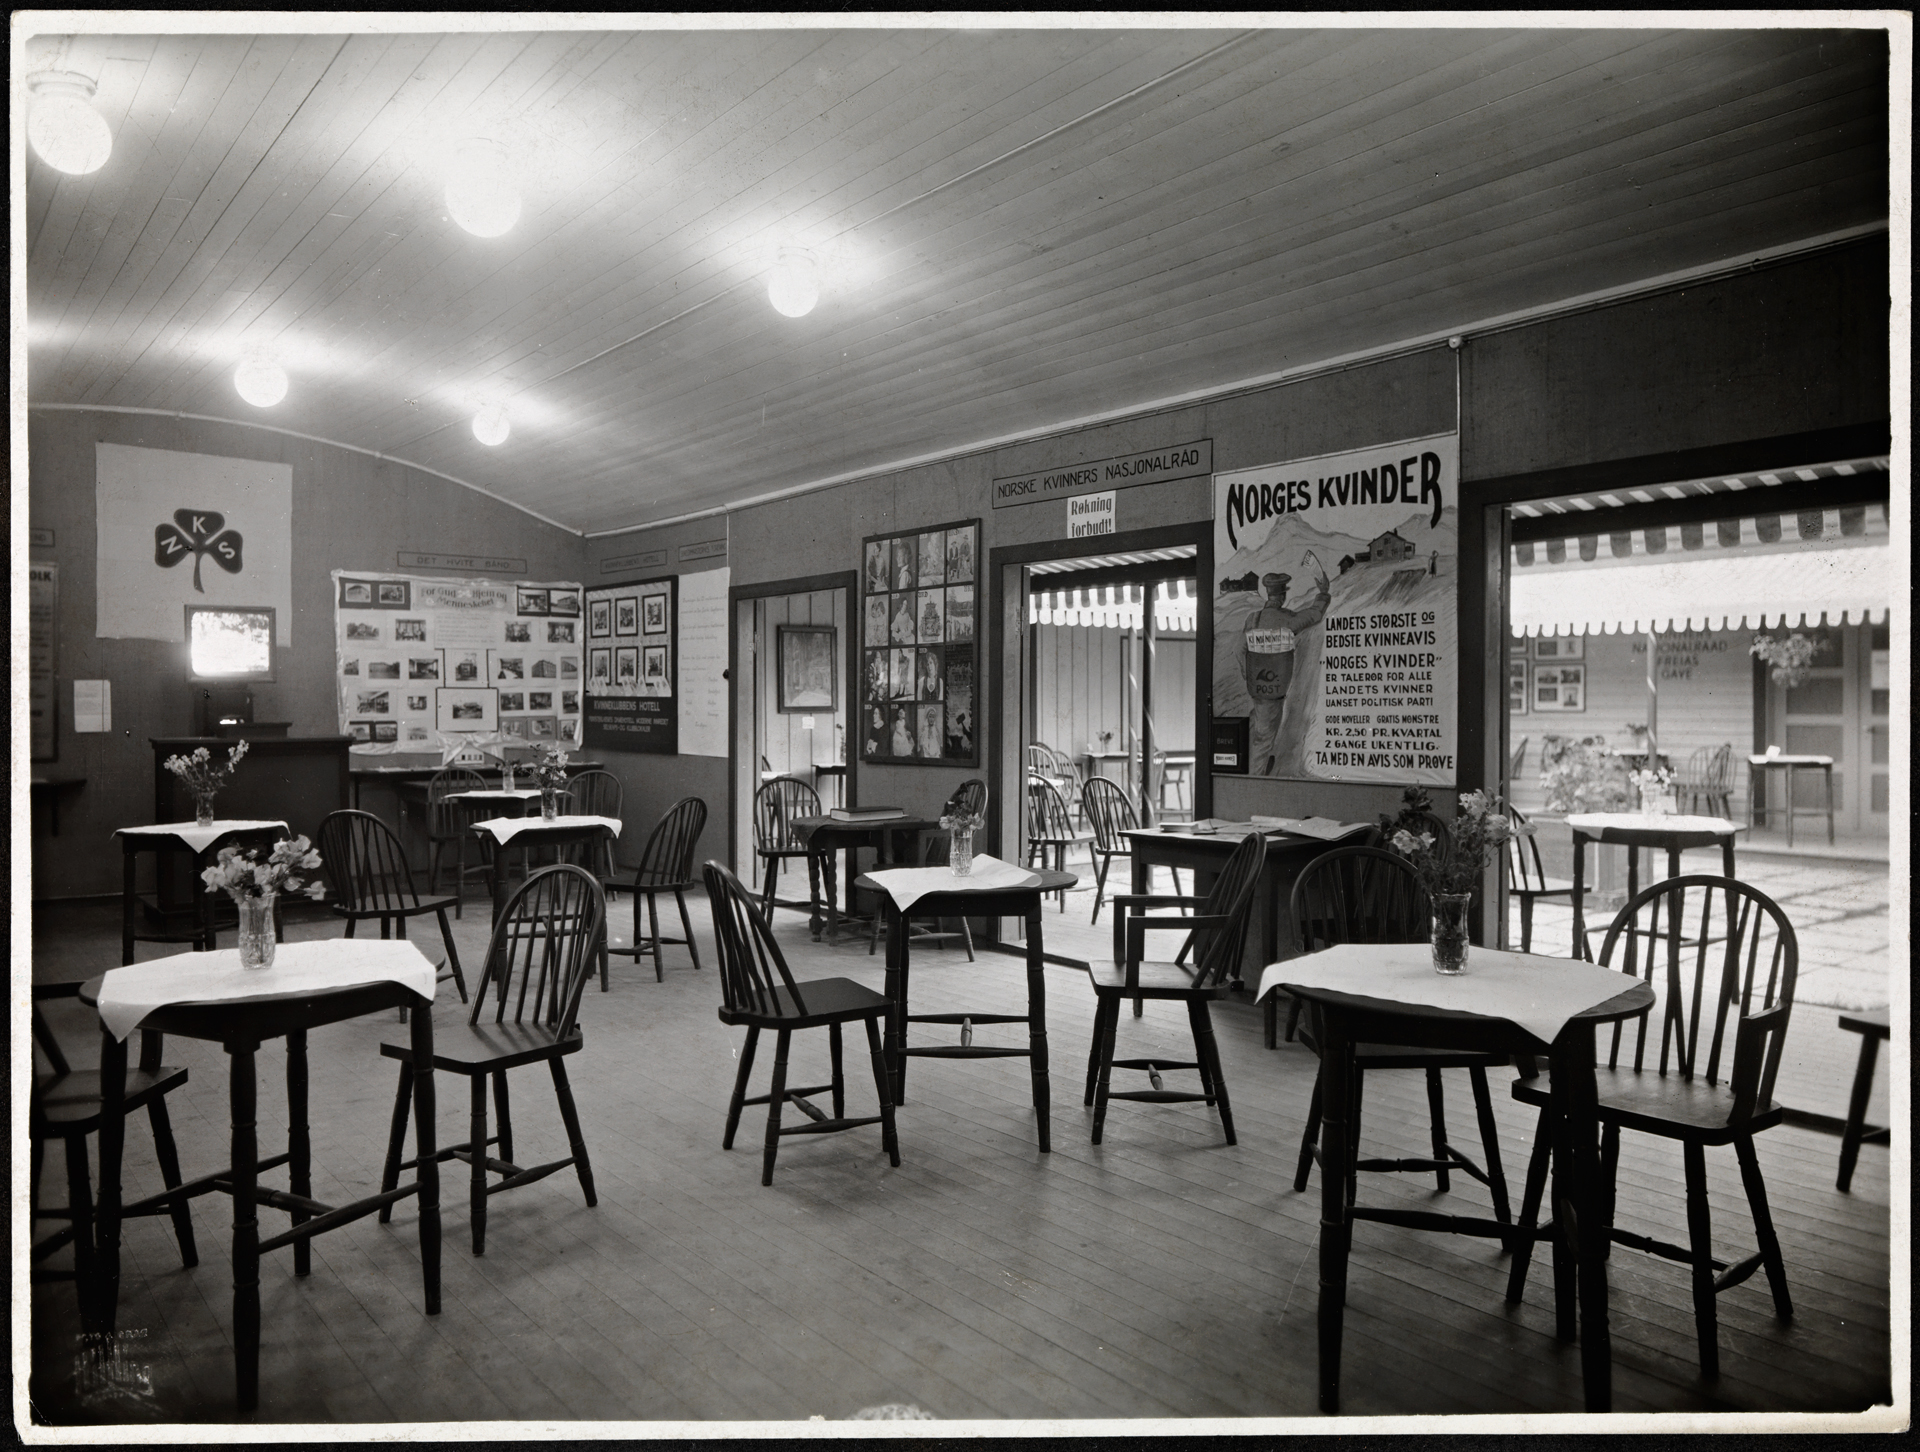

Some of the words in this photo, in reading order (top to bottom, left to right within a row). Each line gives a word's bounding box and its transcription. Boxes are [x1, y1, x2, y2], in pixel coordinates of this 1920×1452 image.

[998, 479, 1037, 498] NORSKE
[1044, 469, 1098, 490] KVINNERS
[1106, 449, 1199, 480] NASJONALRÅD
[1071, 497, 1112, 515] Røkning
[1227, 480, 1312, 550] NORGES
[1319, 451, 1442, 529] KVINDER
[1071, 518, 1112, 537] forbudt!
[417, 556, 437, 564] DET
[447, 558, 474, 567] HVITE
[437, 587, 456, 598] Gud
[1326, 616, 1366, 631] LANDETS
[1370, 613, 1417, 629] STØRSTE
[1422, 611, 1434, 624] OG
[1326, 634, 1361, 648] BEDSTE
[1365, 631, 1436, 647] KVINNEAVIS
[1326, 674, 1337, 682] ER
[1341, 673, 1383, 682] TALERØR
[1387, 672, 1404, 681] FOR
[1409, 671, 1432, 680] ALLE
[1256, 685, 1281, 694] POST
[1326, 686, 1379, 694] LANDETS
[1384, 684, 1433, 694] KVINNER
[639, 702, 660, 711] HOTELL
[1326, 699, 1358, 707] UANSET
[1362, 698, 1404, 707] POLITISK
[1407, 698, 1433, 706] PARTI
[1325, 715, 1340, 723] GODE
[1342, 715, 1370, 723] NOVELLER
[1377, 715, 1400, 723] GRATIS
[1402, 715, 1439, 723] MØNSTRE
[1326, 728, 1342, 736] KR.
[1345, 728, 1367, 737] 2,50
[1325, 740, 1331, 748] 2
[1335, 740, 1367, 749] GANGE
[1316, 752, 1328, 765] TA
[1331, 753, 1348, 766] MED
[1351, 753, 1364, 767] EN
[1367, 754, 1390, 767] AVIS
[1393, 754, 1413, 768] SOM
[1419, 755, 1453, 769] PRØVE
